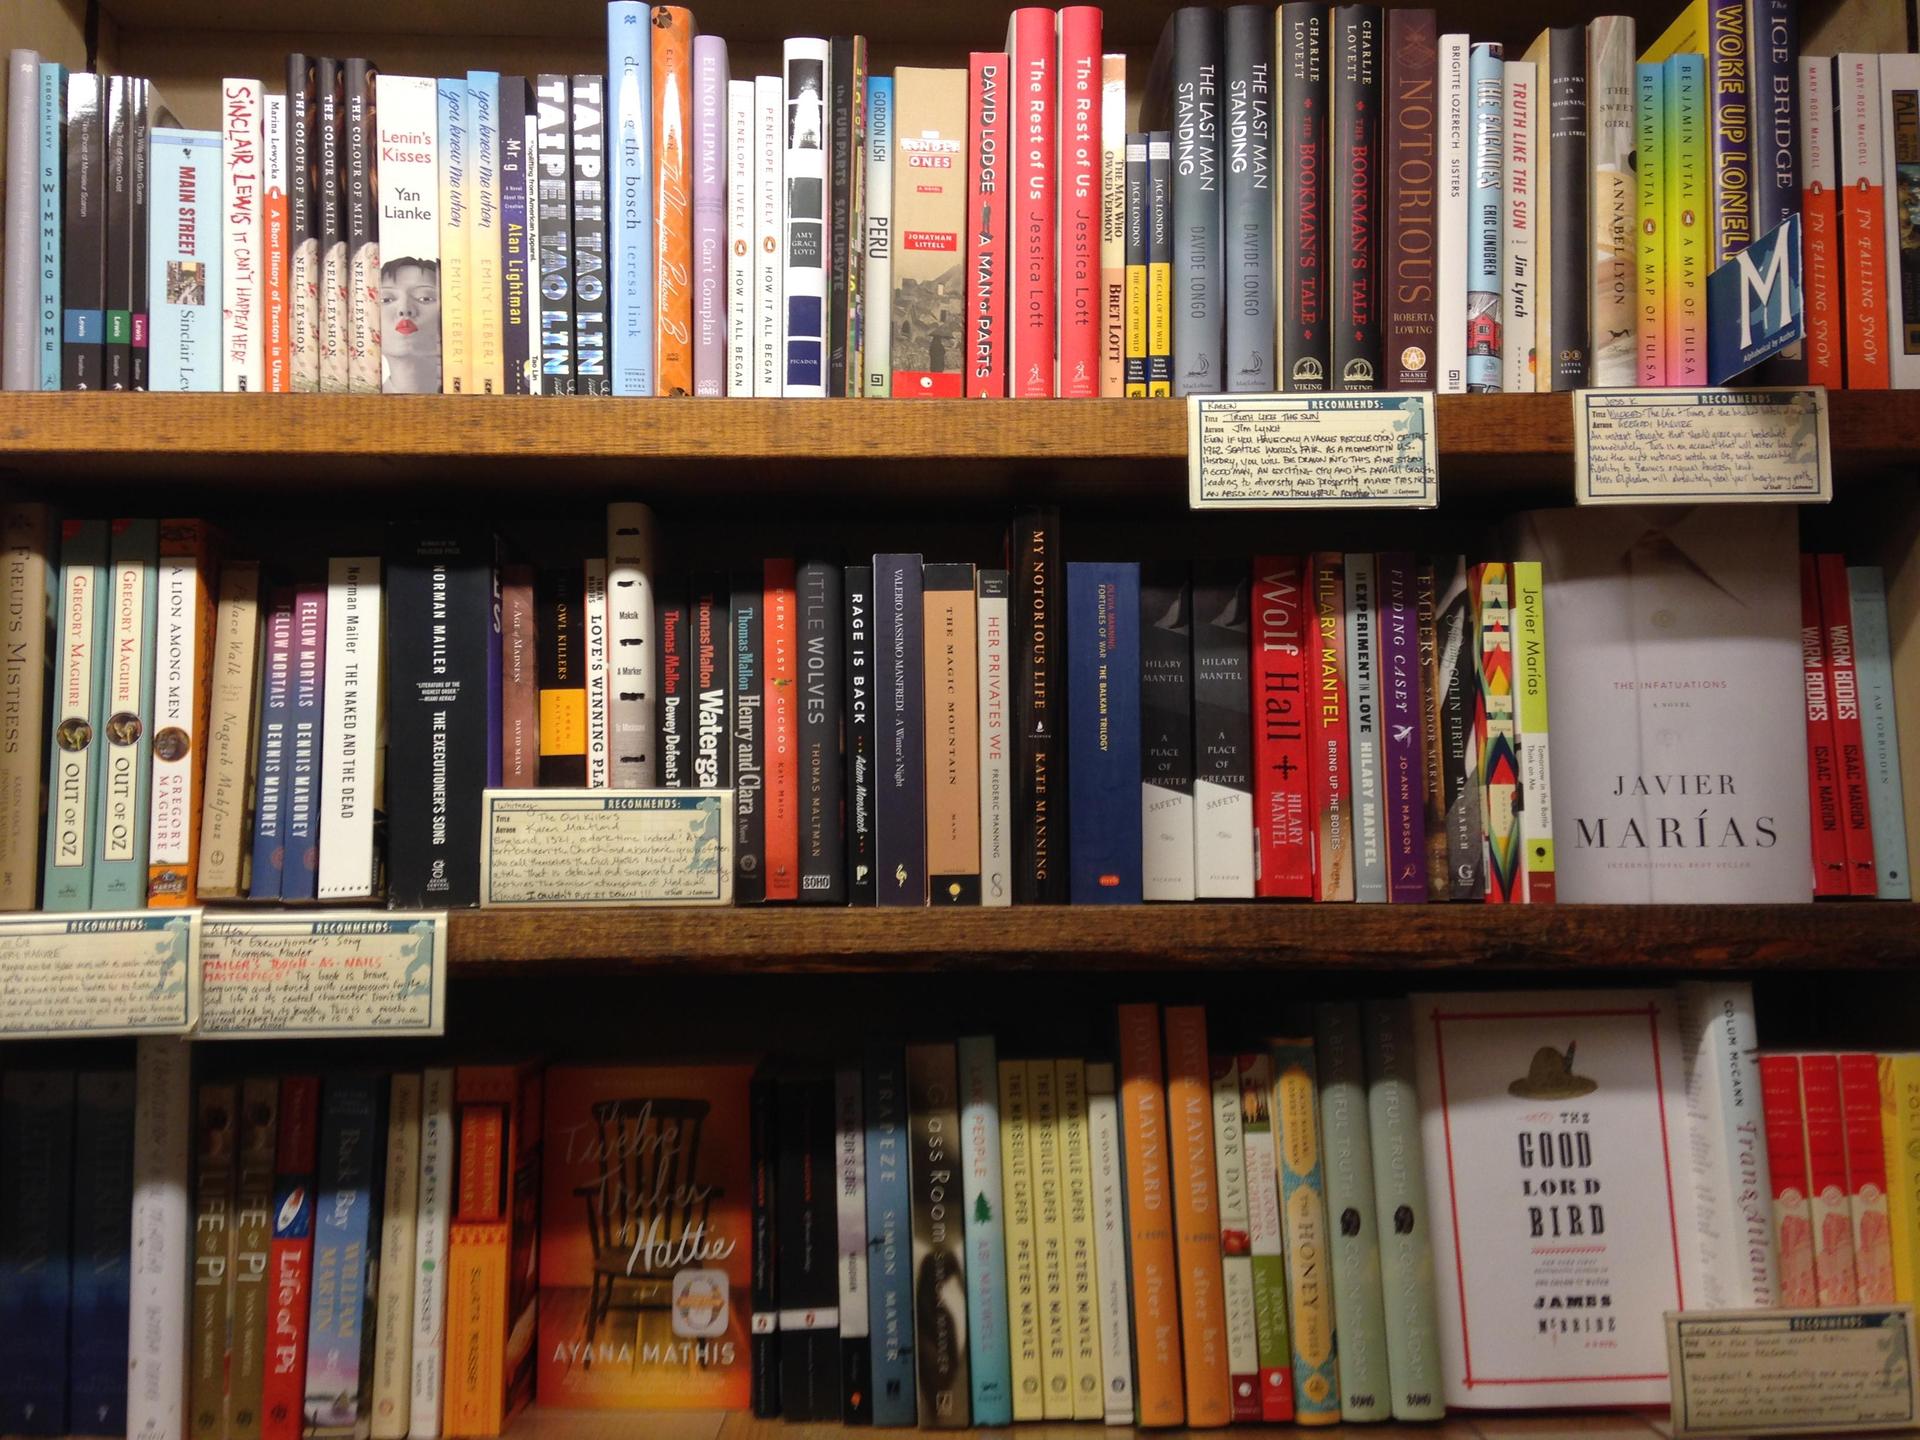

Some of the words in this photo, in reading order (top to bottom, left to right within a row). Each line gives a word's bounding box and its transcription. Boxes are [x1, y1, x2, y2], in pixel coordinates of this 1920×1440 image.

[1295, 22, 1304, 78] LOVETT
[1310, 18, 1320, 82] CHARLIE
[1716, 6, 1744, 94] WOKE
[1771, 17, 1788, 63] ICE
[704, 57, 715, 118] ELINOR
[983, 66, 996, 124] DAVID
[1030, 59, 1045, 92] The
[1200, 65, 1214, 96] THE
[295, 91, 304, 113] THE
[876, 91, 886, 136] GORDON
[1030, 100, 1045, 144] Rest
[1200, 101, 1214, 140] LAST
[1513, 83, 1527, 123] TRUTH
[382, 130, 431, 144] Lenin's
[1179, 83, 1194, 176] STANDING
[1513, 129, 1526, 158] LIKE
[1719, 105, 1747, 144] UP
[1774, 74, 1792, 188] BRIDGE
[295, 119, 305, 172] COLOUR
[382, 149, 431, 164] Kisses
[703, 121, 715, 185] LIPMAN
[875, 140, 885, 162] LISH
[982, 131, 995, 193] LODGE
[1030, 150, 1045, 170] of
[179, 166, 196, 211] MAIN
[1030, 176, 1044, 199] Us
[1200, 147, 1214, 191] MAN
[1513, 165, 1526, 195] THE
[230, 174, 251, 227] LEWIS
[396, 188, 420, 202] Yan
[1300, 144, 1317, 268] BOOKMAN'S
[1399, 79, 1433, 303] NOTORIOUS
[43, 168, 55, 279] SWIMMING
[296, 204, 305, 232] MILK
[385, 206, 431, 220] Lianke
[1512, 200, 1525, 230] SUN
[1614, 178, 1624, 255] ANNABEL
[178, 214, 195, 256] STREET
[233, 232, 246, 246] IT
[508, 224, 522, 253] Alan
[870, 216, 887, 259] PERU
[979, 234, 991, 246] A
[1029, 211, 1045, 280] Jessica
[296, 256, 304, 286] NELL
[979, 256, 991, 298] MAN
[1516, 255, 1528, 279] Jim
[1614, 260, 1624, 305] LYON
[1735, 221, 1792, 350] M
[232, 287, 250, 335] HAPPEN
[508, 257, 522, 325] Lightman
[1030, 290, 1043, 328] Lott
[1301, 277, 1316, 324] TALE
[1511, 284, 1527, 317] Lynch
[45, 296, 54, 352] HOME
[296, 291, 305, 354] LEYSHON
[1394, 313, 1434, 322] ROBERTA
[1395, 326, 1432, 334] LOWING
[231, 338, 248, 364] HERE
[977, 319, 990, 378] PARTS
[1743, 341, 1771, 362] Alphabetical
[1312, 400, 1384, 409] RECOMMENDS:
[1033, 531, 1045, 555] MY
[172, 565, 183, 576] A
[347, 567, 360, 610] Norman
[172, 579, 183, 617] LION
[433, 565, 446, 619] NORMAN
[1319, 570, 1337, 641] HILARY
[1522, 587, 1537, 632] Javier
[300, 602, 317, 646] FELLOW
[558, 602, 566, 630] OWL
[852, 594, 864, 640] RAGE
[987, 616, 1001, 648] HER
[1032, 561, 1046, 665] NOTORIOUS
[1261, 570, 1299, 657] Wolf
[169, 623, 182, 681] AMONG
[346, 615, 359, 654] Mailer
[433, 625, 446, 674] MAILER
[1830, 625, 1852, 667] WARM
[345, 664, 358, 685] THE
[557, 635, 566, 681] KILLERS
[853, 648, 864, 666] IS
[1200, 672, 1243, 681] MANTEL
[1202, 658, 1240, 666] HILARY
[1526, 633, 1539, 696] Marías
[299, 650, 315, 707] MORTALS
[988, 654, 1001, 728] PRIVATES
[1033, 671, 1046, 710] LIFE
[1322, 648, 1339, 729] MANTEL
[1613, 681, 1634, 690] THE
[1640, 681, 1727, 689] INFATUATIONS
[1834, 671, 1856, 719] BODIES
[168, 686, 179, 719] MEN
[344, 689, 357, 729] NAKED
[854, 676, 865, 724] BACK
[1264, 670, 1301, 741] Hall
[433, 711, 446, 730] THE
[296, 723, 312, 772] DENNIS
[343, 734, 355, 756] AND
[988, 734, 1001, 760] WE
[1328, 740, 1337, 771] BRING
[1844, 744, 1861, 779] ISAAC
[64, 764, 80, 804] OUT
[342, 760, 354, 782] THE
[433, 732, 446, 814] EXECUTIONER'S
[991, 769, 1001, 809] FREDERIC
[1035, 753, 1046, 794] KATE
[1330, 775, 1338, 788] UP
[1614, 775, 1736, 795] JAVIER
[292, 776, 310, 838] MAHONEY
[341, 787, 354, 819] DEAD
[607, 798, 681, 809] RECOMMENDS:
[1330, 793, 1339, 811] THE
[1847, 783, 1866, 829] MARION
[61, 830, 77, 857] OZ
[432, 816, 446, 844] SONG
[991, 814, 1001, 859] MANNING
[1035, 800, 1047, 880] MANNING
[1331, 815, 1340, 850] BODIES
[1574, 809, 1777, 848] MARÍAS
[803, 876, 830, 889] SOHO
[316, 922, 392, 935] RECOMMENDS:
[1724, 1001, 1736, 1047] COLUM
[878, 1072, 895, 1183] TRAPEZE
[1560, 1113, 1590, 1124] THE
[1184, 1096, 1208, 1213] MAYNARD
[1518, 1131, 1592, 1169] GOOD
[1522, 1179, 1600, 1196] LORD
[1528, 1205, 1605, 1238] BIRD
[626, 1217, 737, 1276] Hattie
[882, 1211, 895, 1275] SIMON
[279, 1250, 301, 1305] Life
[1074, 1239, 1088, 1295] PETER
[1534, 1295, 1612, 1308] JAMES
[277, 1309, 296, 1340] of
[884, 1293, 898, 1362] MAWER
[1077, 1302, 1092, 1359] MAYLE
[275, 1343, 296, 1373] Pi
[553, 1343, 633, 1362] AYANA
[642, 1343, 735, 1363] MATHIS
